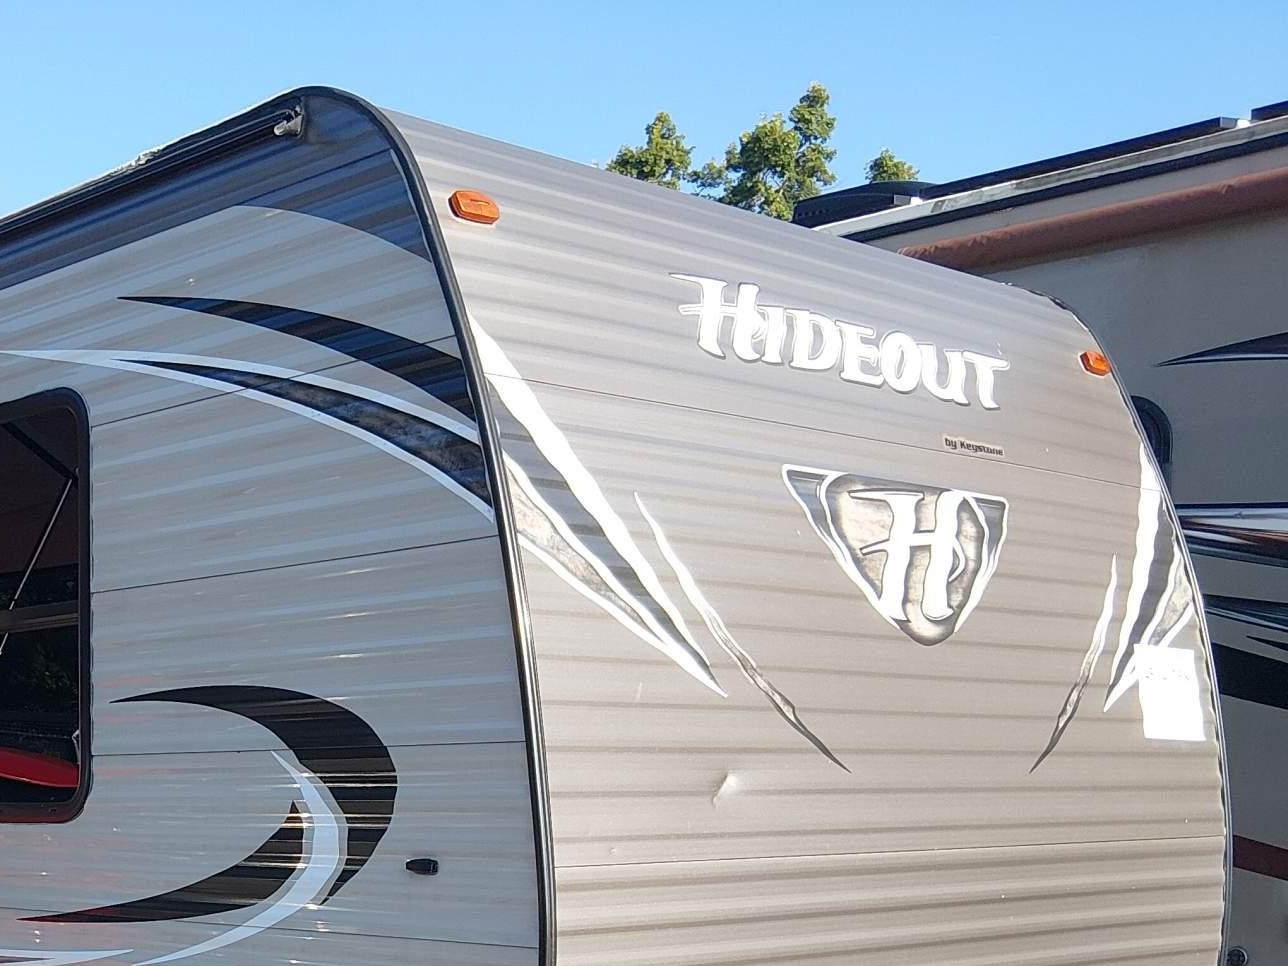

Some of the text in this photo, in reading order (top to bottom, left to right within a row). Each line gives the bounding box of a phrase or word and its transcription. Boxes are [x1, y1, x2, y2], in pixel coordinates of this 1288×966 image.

[668, 272, 1010, 410] HIDEOUT
[944, 437, 1004, 456] by Keystone
